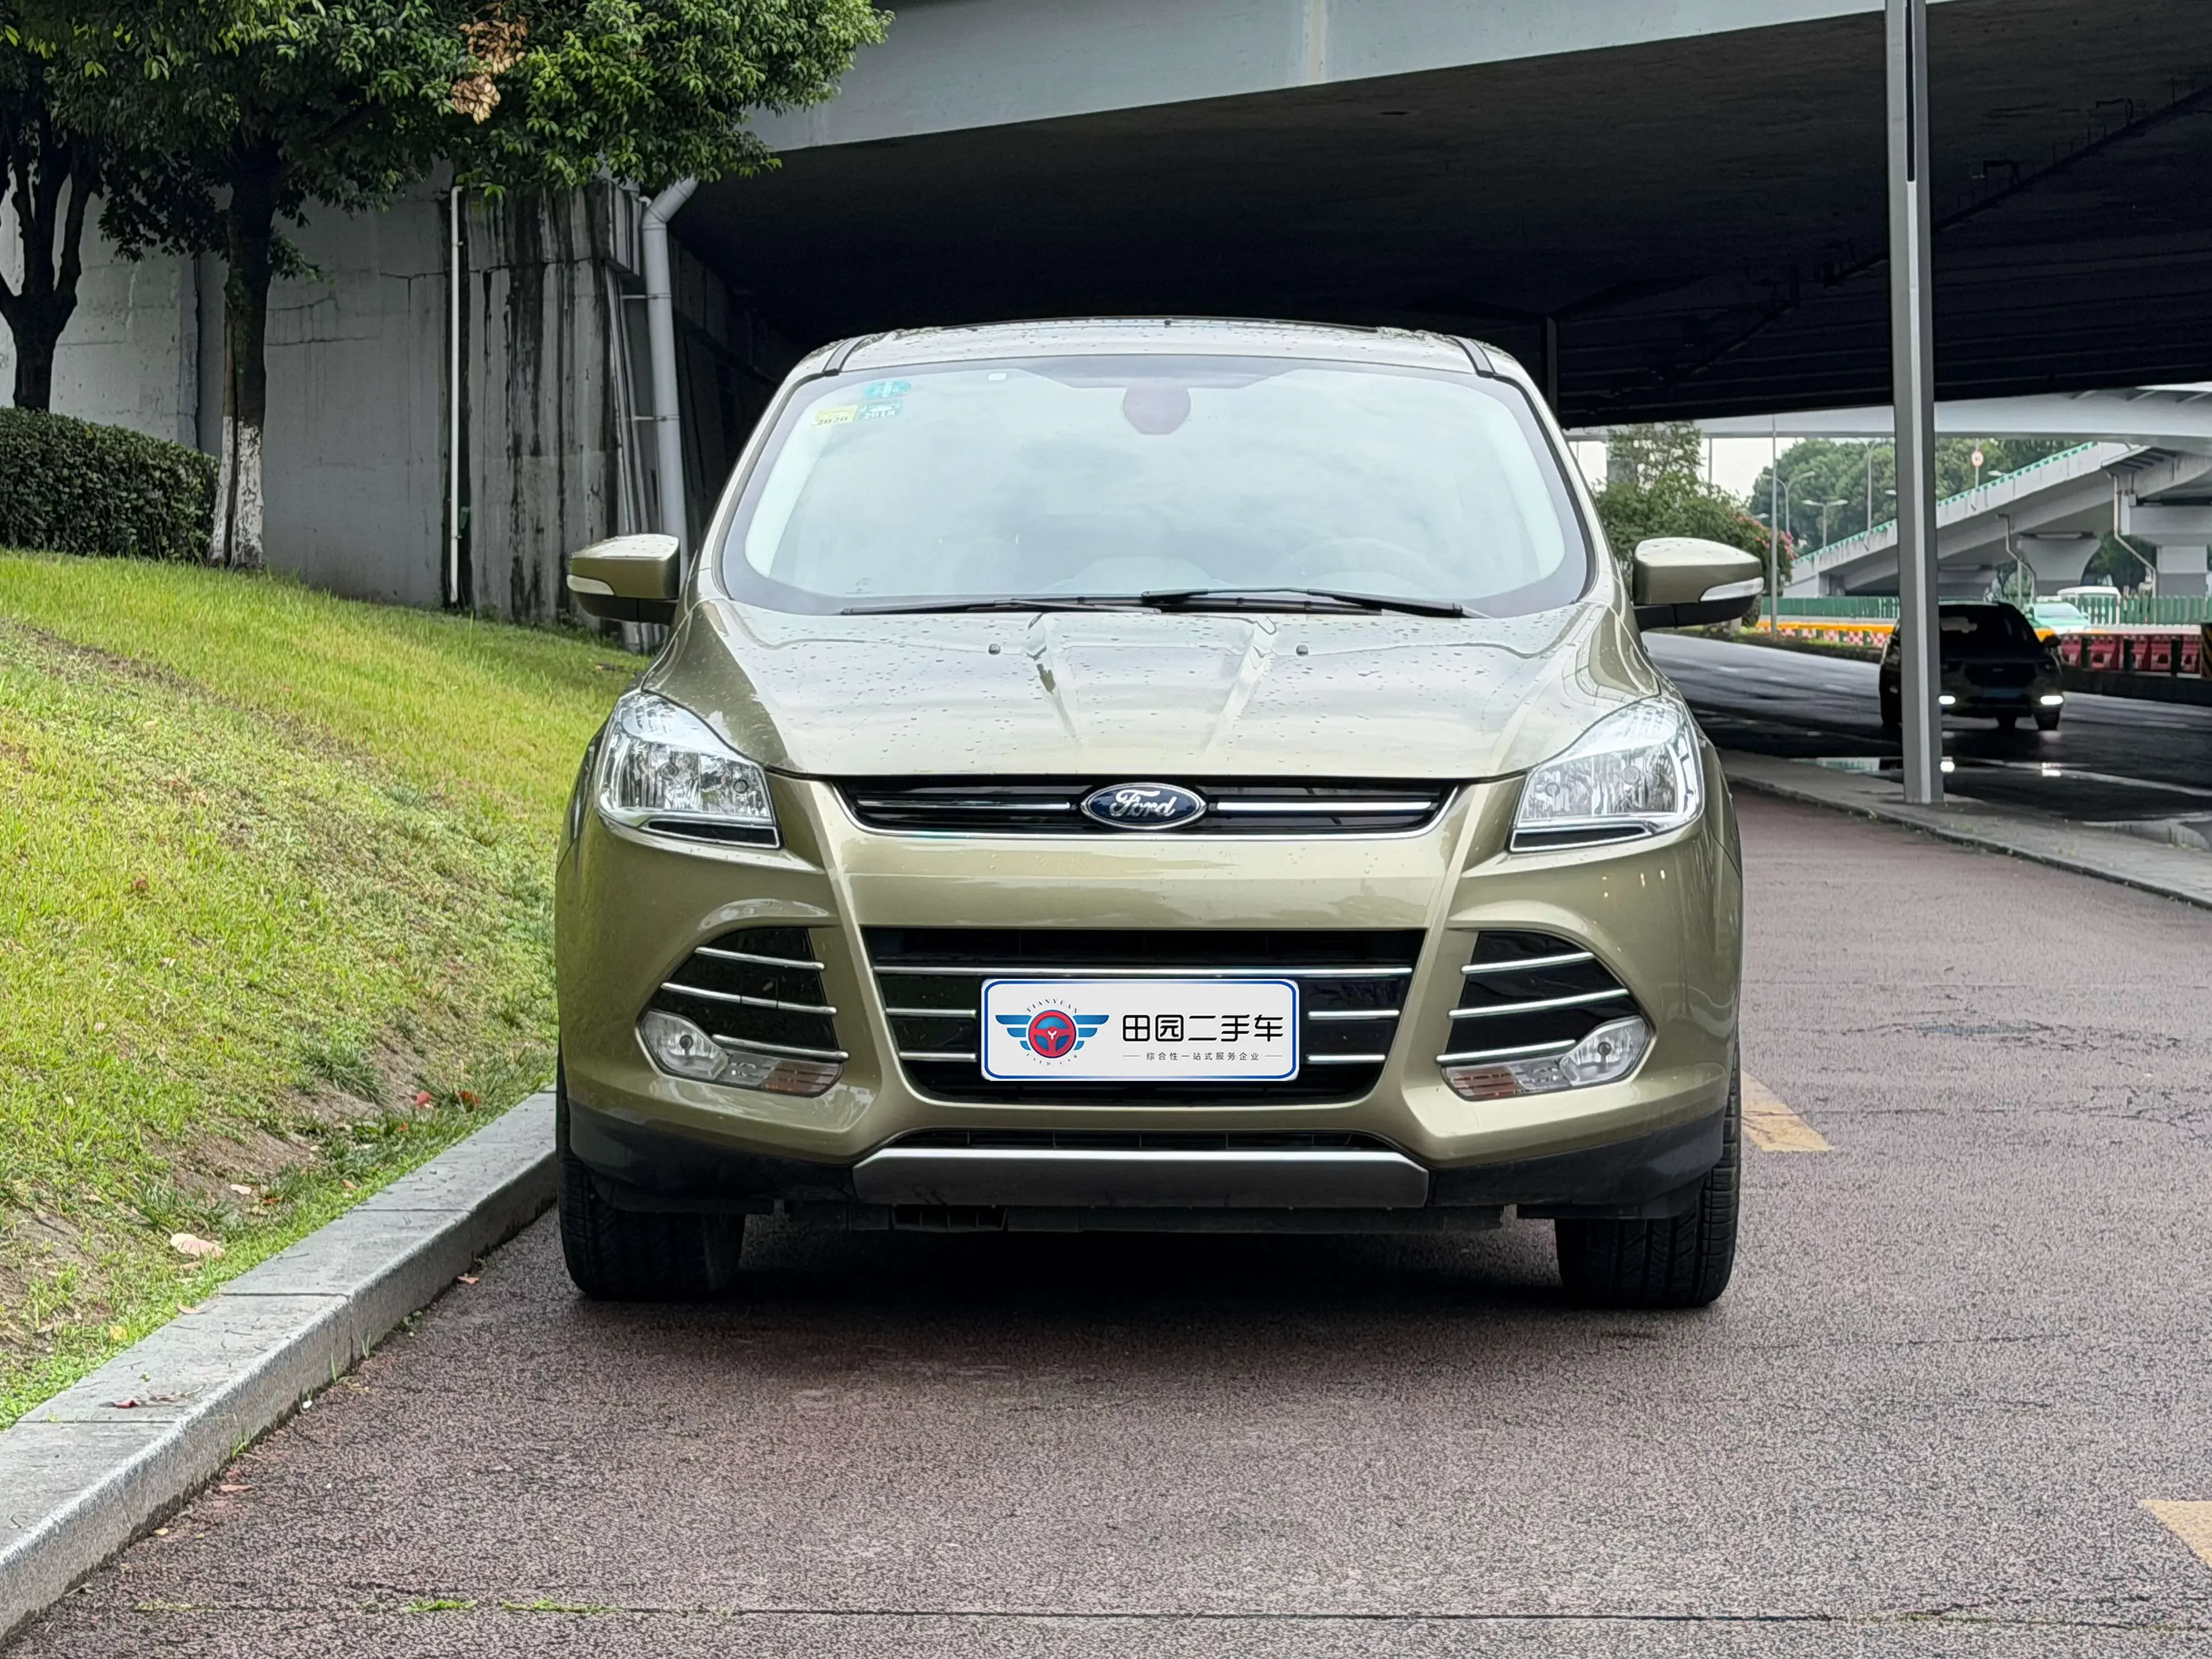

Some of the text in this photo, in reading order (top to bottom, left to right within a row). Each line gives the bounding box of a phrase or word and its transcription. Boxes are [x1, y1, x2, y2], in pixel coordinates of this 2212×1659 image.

[1109, 789, 1177, 817] Ford
[1122, 1014, 1284, 1042] 田园二手车
[1146, 1051, 1259, 1060] 综合性一站式服务企业
